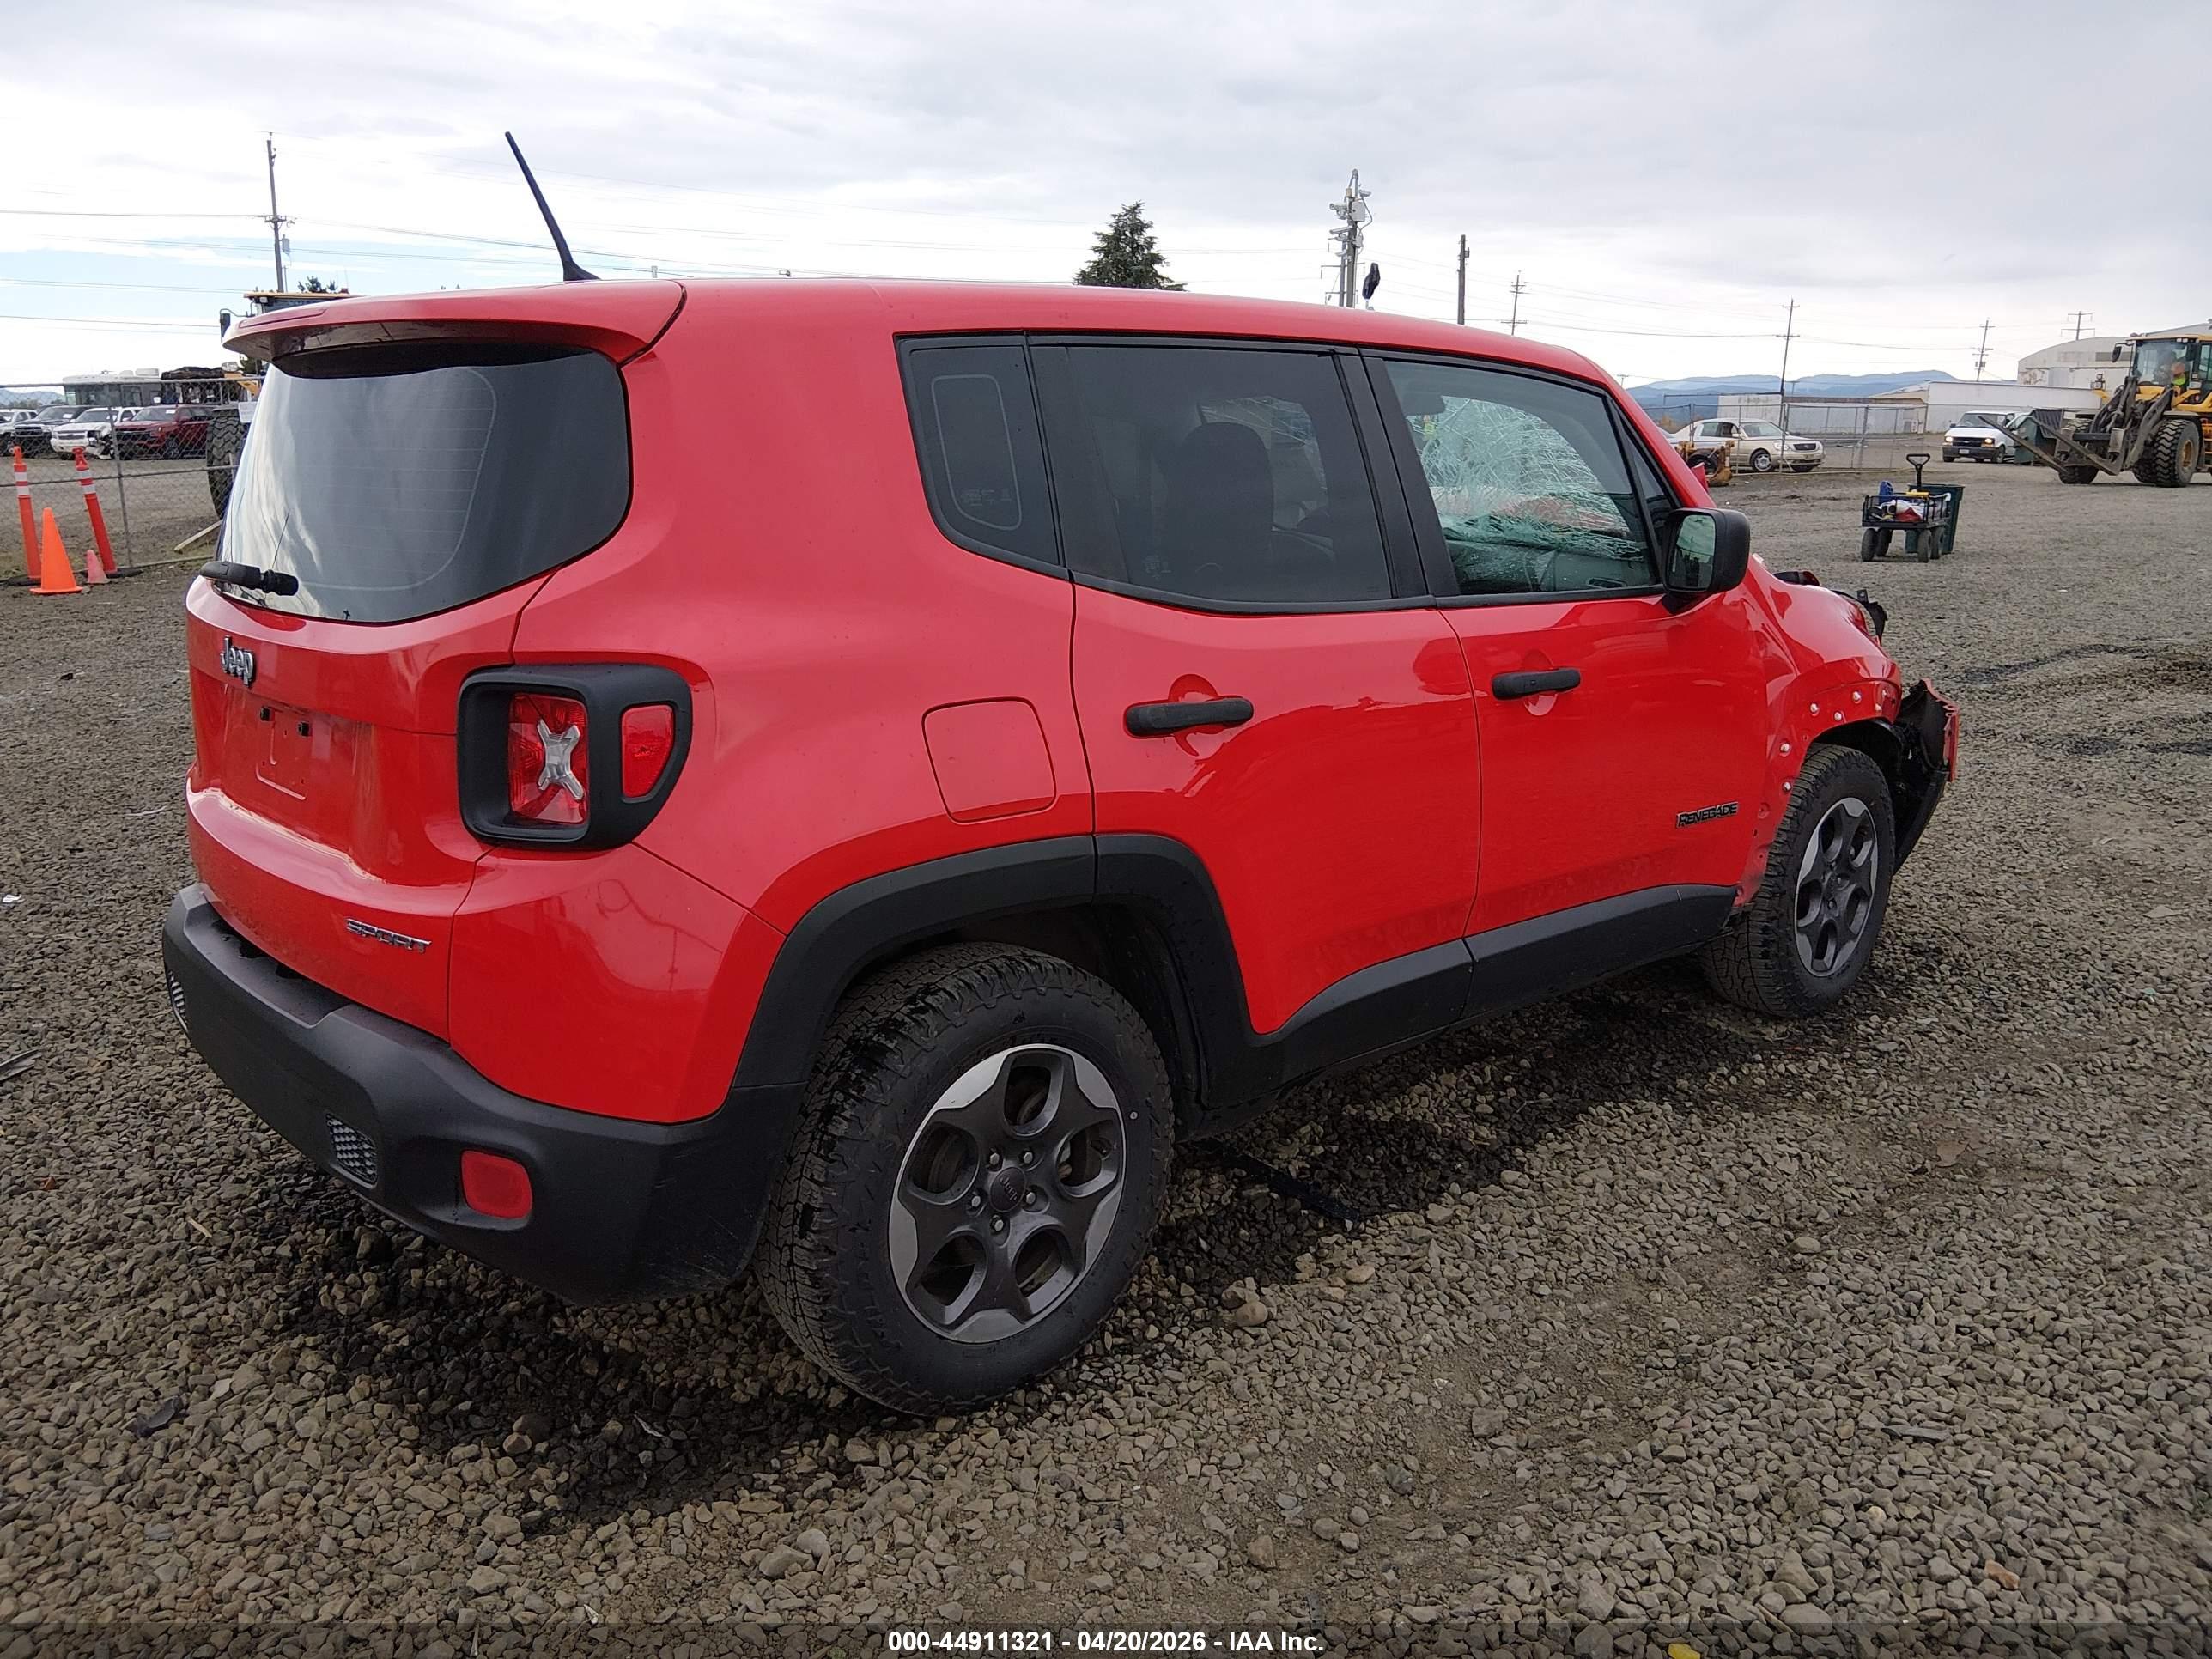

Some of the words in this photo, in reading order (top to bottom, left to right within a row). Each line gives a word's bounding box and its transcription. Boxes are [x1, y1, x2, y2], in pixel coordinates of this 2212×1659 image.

[220, 635, 255, 688] Jeep
[1676, 801, 1739, 829] RENEGADE
[345, 917, 432, 953] SPORT
